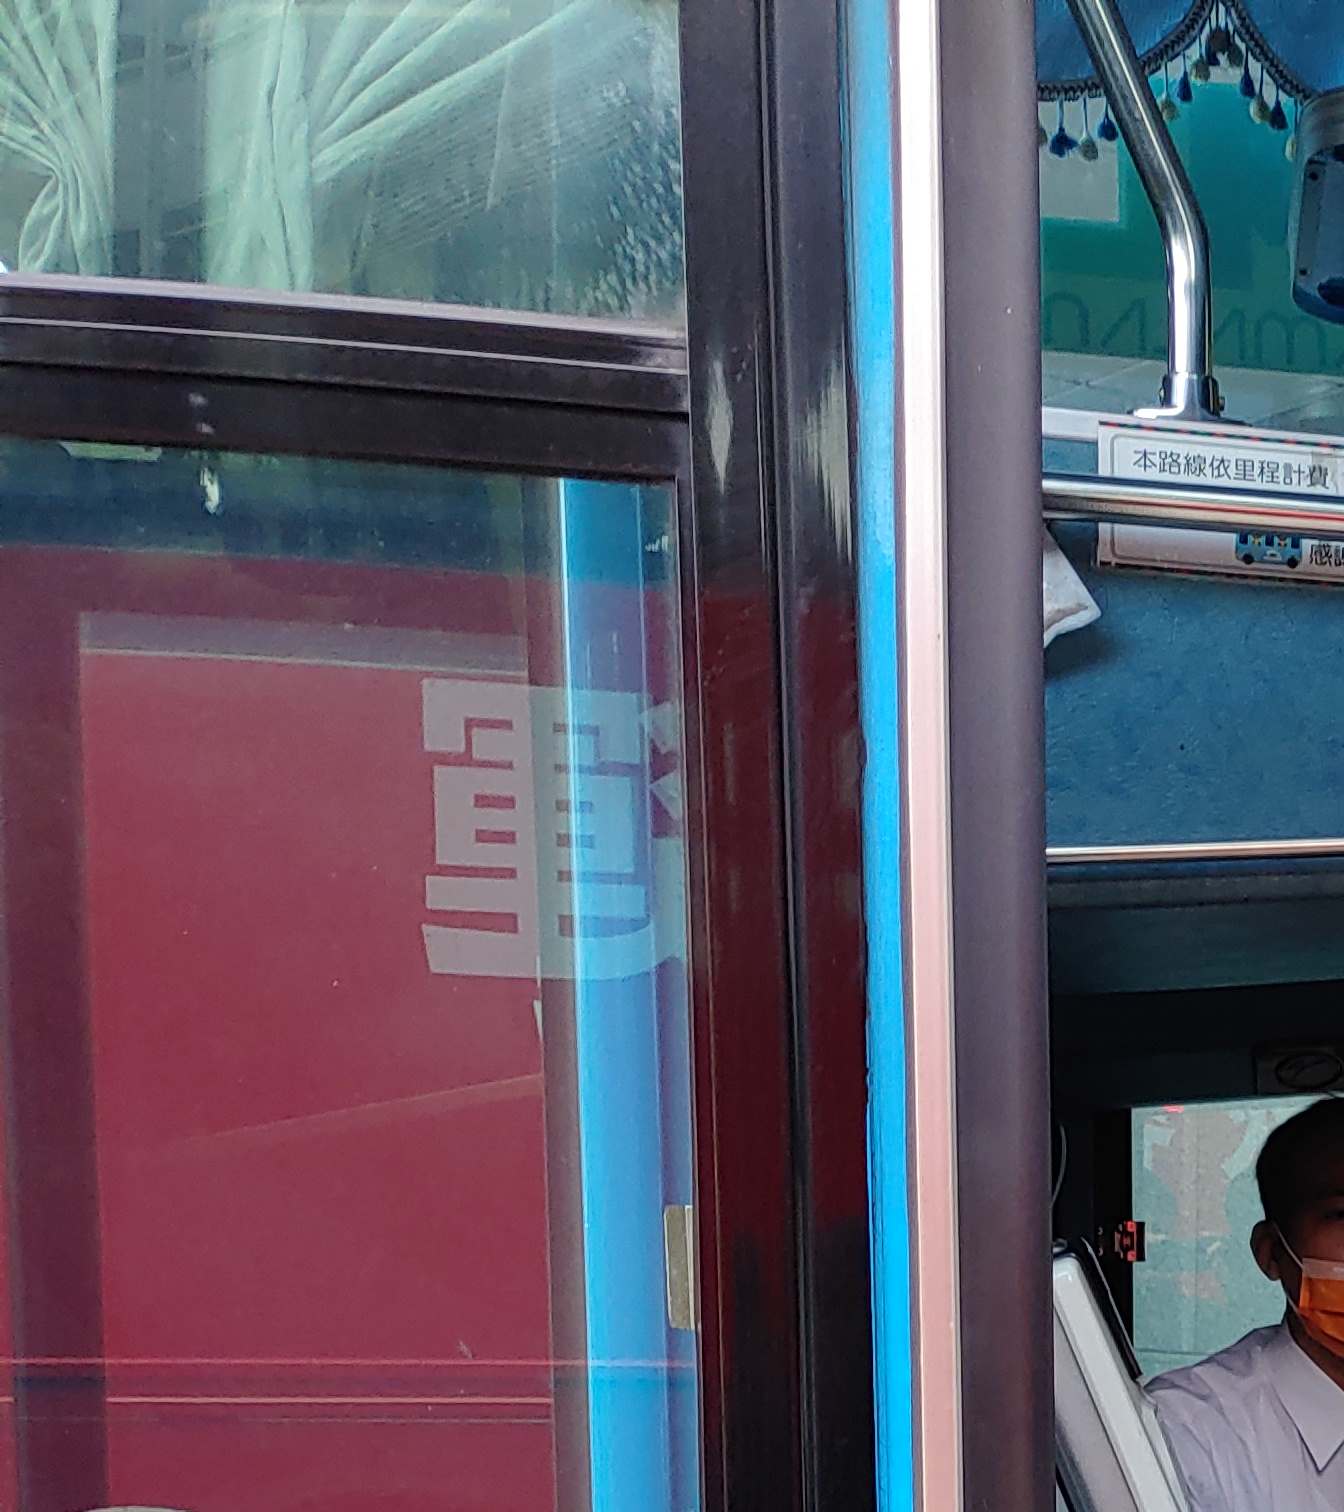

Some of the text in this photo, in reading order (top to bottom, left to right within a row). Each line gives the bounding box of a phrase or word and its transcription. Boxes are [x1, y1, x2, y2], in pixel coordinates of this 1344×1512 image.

[1133, 447, 1331, 490] 本路線依里程計費
